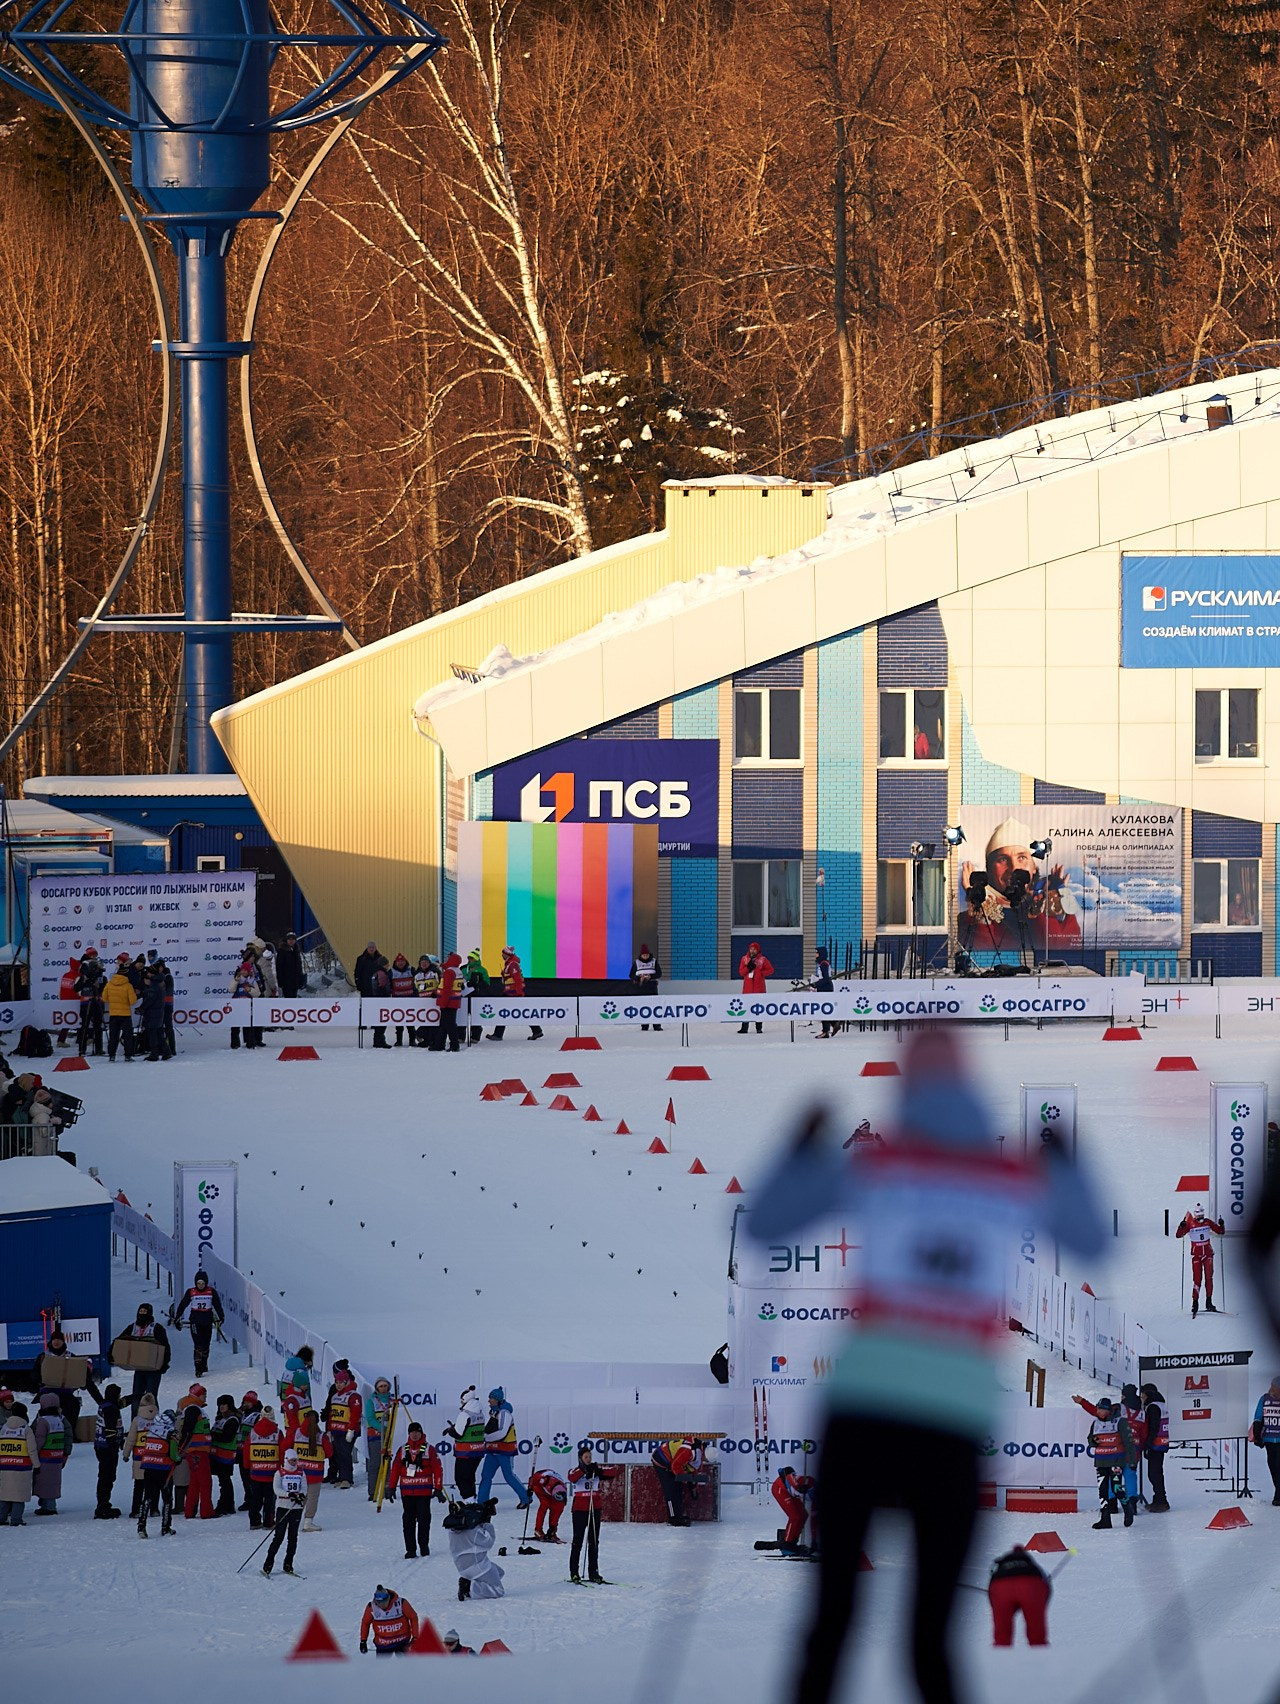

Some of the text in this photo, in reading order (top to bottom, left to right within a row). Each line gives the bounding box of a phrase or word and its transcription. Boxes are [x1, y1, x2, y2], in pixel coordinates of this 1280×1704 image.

[1142, 626, 1197, 638] СОЗДАЁМ
[1199, 626, 1244, 637] КЛИМАТ
[1246, 627, 1253, 637] В
[588, 780, 691, 819] ПСБ
[1111, 815, 1175, 824] КУЛАКОВА
[1049, 828, 1175, 837] ГАЛИНА АЛЕКСЕЕВНА
[658, 842, 691, 852] ДМУРТИИ
[41, 882, 246, 899] ФОСАГРО КУБОК РОССИИ ПО ЛЫЖНЫМ ГОНКАМ
[114, 904, 132, 913] ЭТАП
[149, 902, 180, 911] ИЖЕВСК
[623, 1004, 708, 1019] ФОСАГРО
[750, 1001, 834, 1017] ФОСАГРО
[876, 999, 960, 1015] ФОСАГРО
[1002, 997, 1086, 1013] ФОСАГРО
[172, 1009, 223, 1025] OSCO
[271, 1008, 332, 1024] BOSCO
[380, 1008, 440, 1023] BOSCO
[498, 1007, 566, 1020] ФОСАГРО
[1230, 1125, 1245, 1216] ФОСАГРО
[1155, 1354, 1234, 1368] ИНФОРМАЦИЯ
[752, 1378, 807, 1386] РУСКЛИМАТ
[1193, 1399, 1201, 1408] 18
[1, 1443, 22, 1453] СУДЬЯ
[577, 1438, 662, 1454] ФОСАГР
[719, 1438, 817, 1455] ФОСАГРО
[252, 1449, 276, 1458] СУДЬЯ
[287, 1482, 298, 1491] 58
[377, 1622, 403, 1634] ТРЕНЕР
